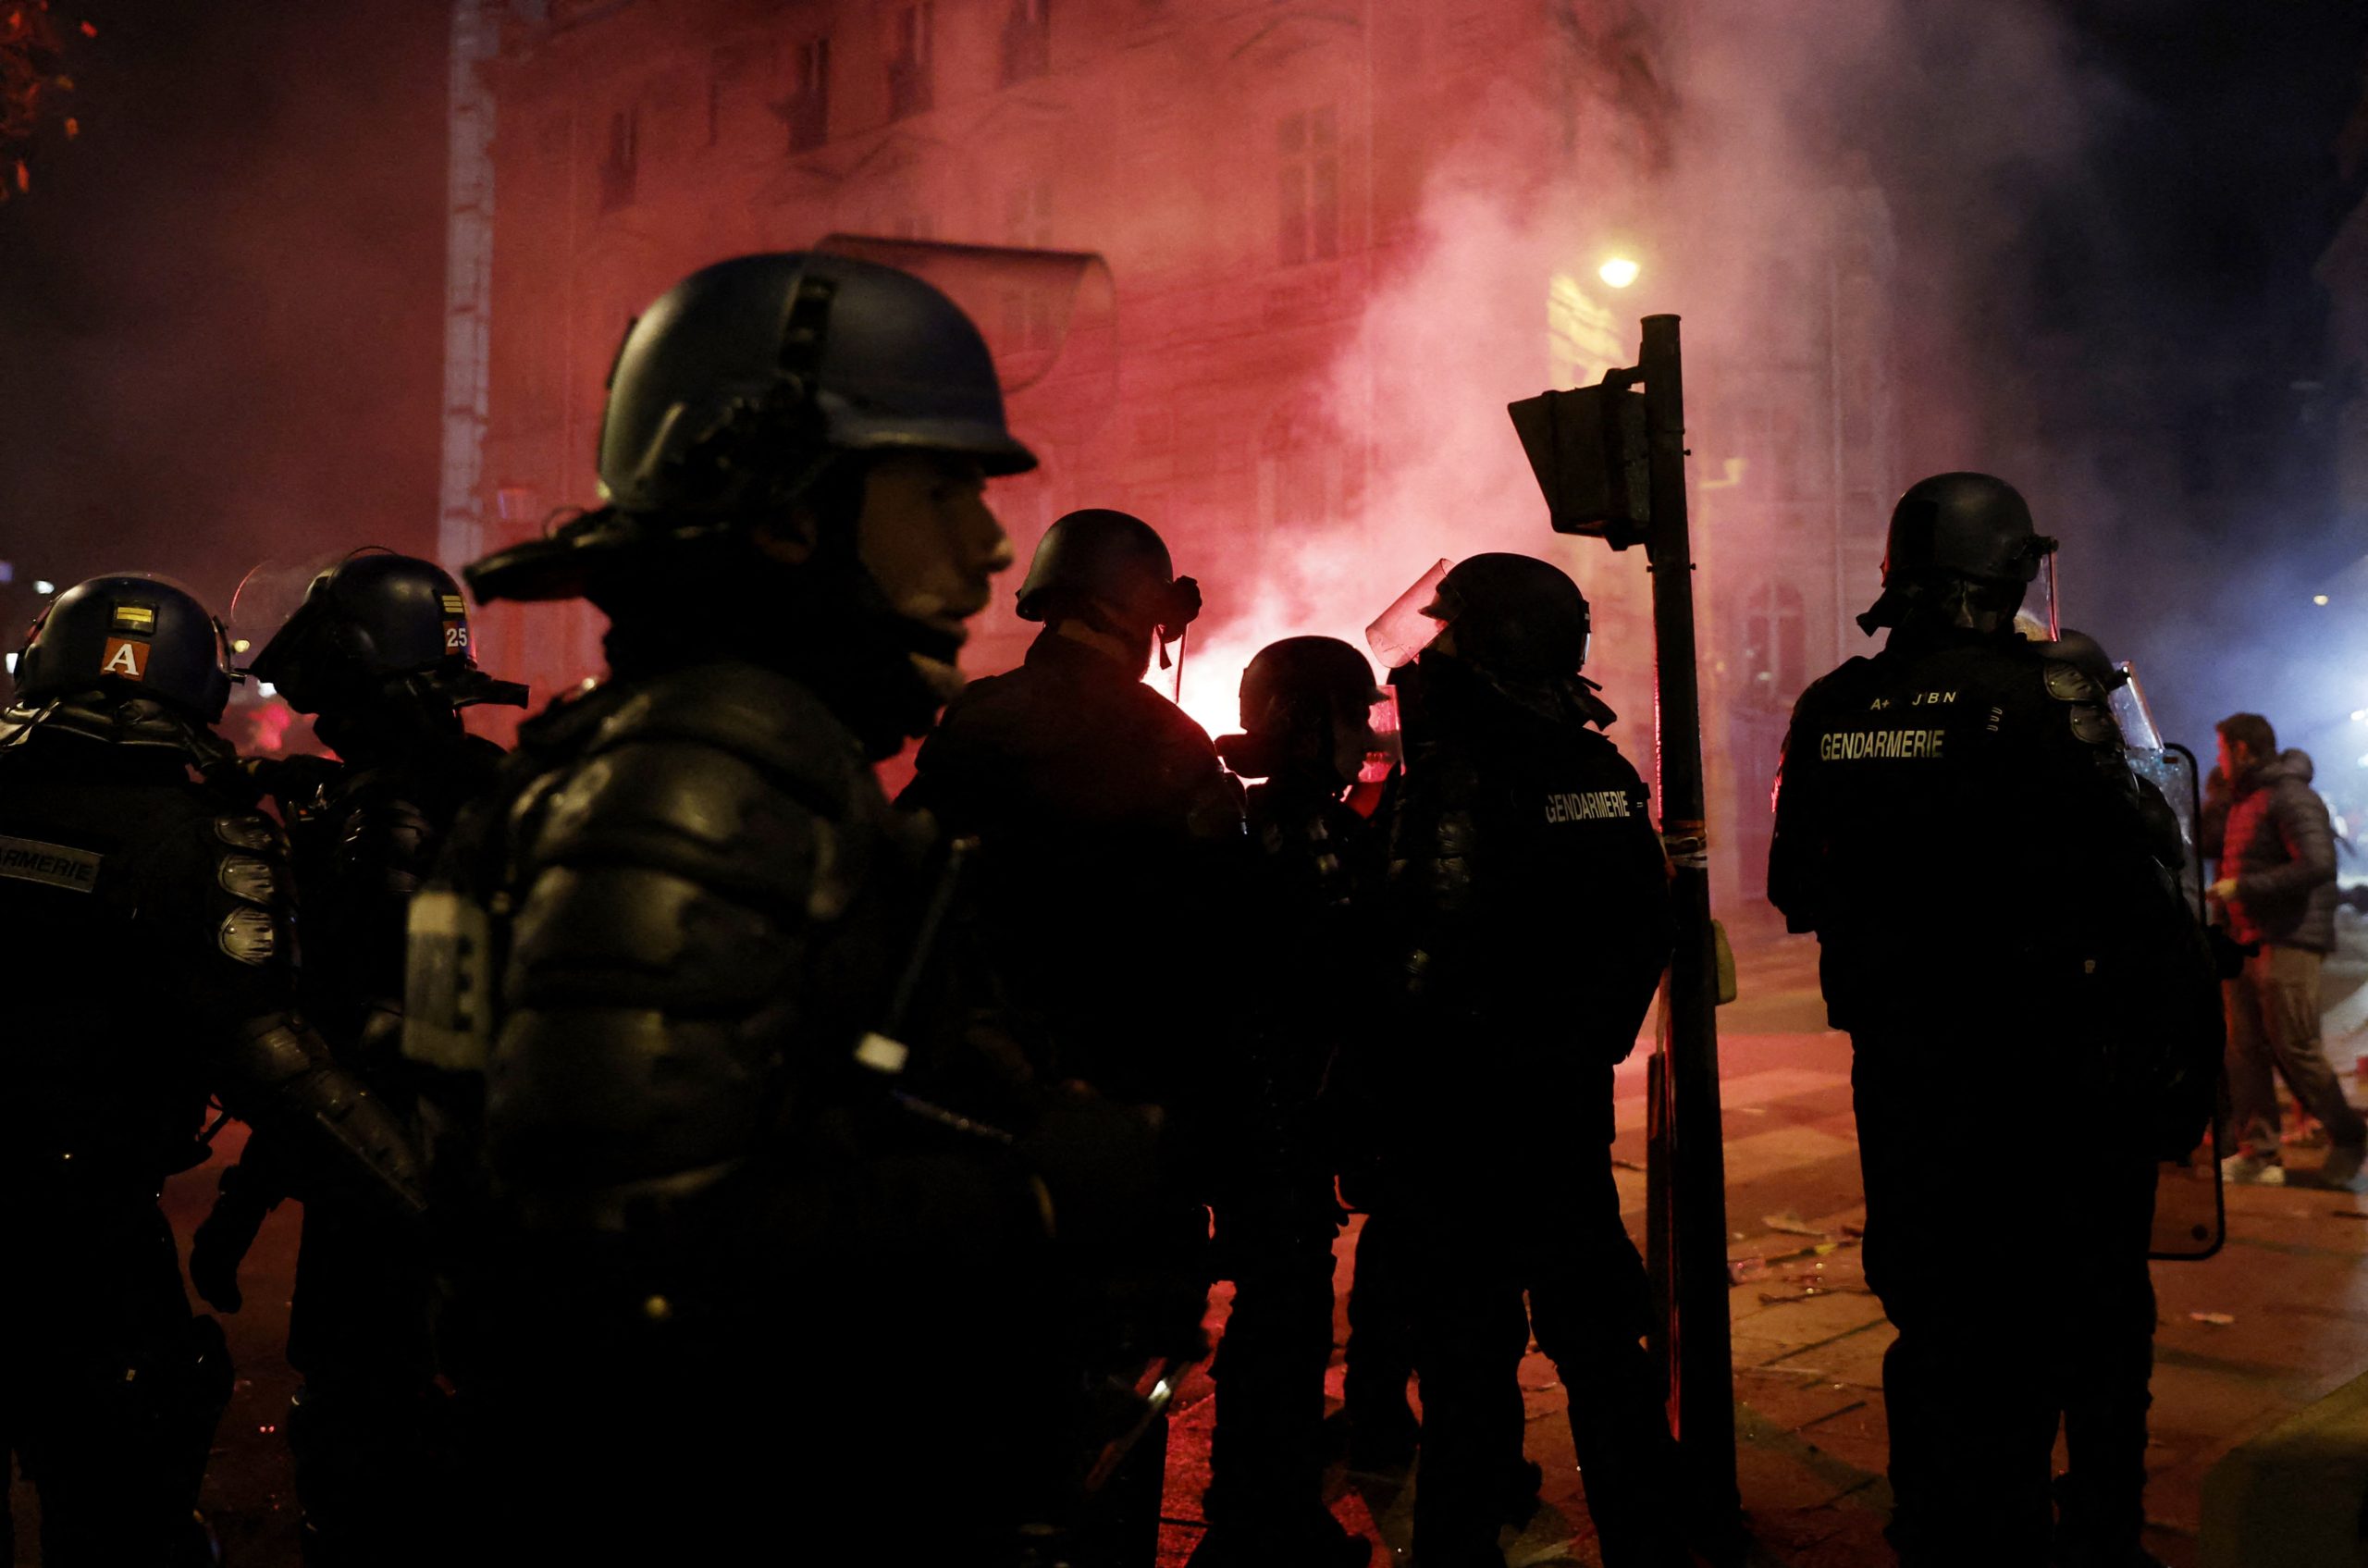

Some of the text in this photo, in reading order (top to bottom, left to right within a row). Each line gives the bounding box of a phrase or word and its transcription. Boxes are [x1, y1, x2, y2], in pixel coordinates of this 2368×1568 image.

[446, 627, 468, 647] 25
[104, 643, 140, 676] A
[1869, 698, 1890, 710] A+
[1821, 729, 1945, 761] GENDARMERIE
[1545, 790, 1631, 824] GENDARMERIE
[0, 847, 94, 883] RMERIE
